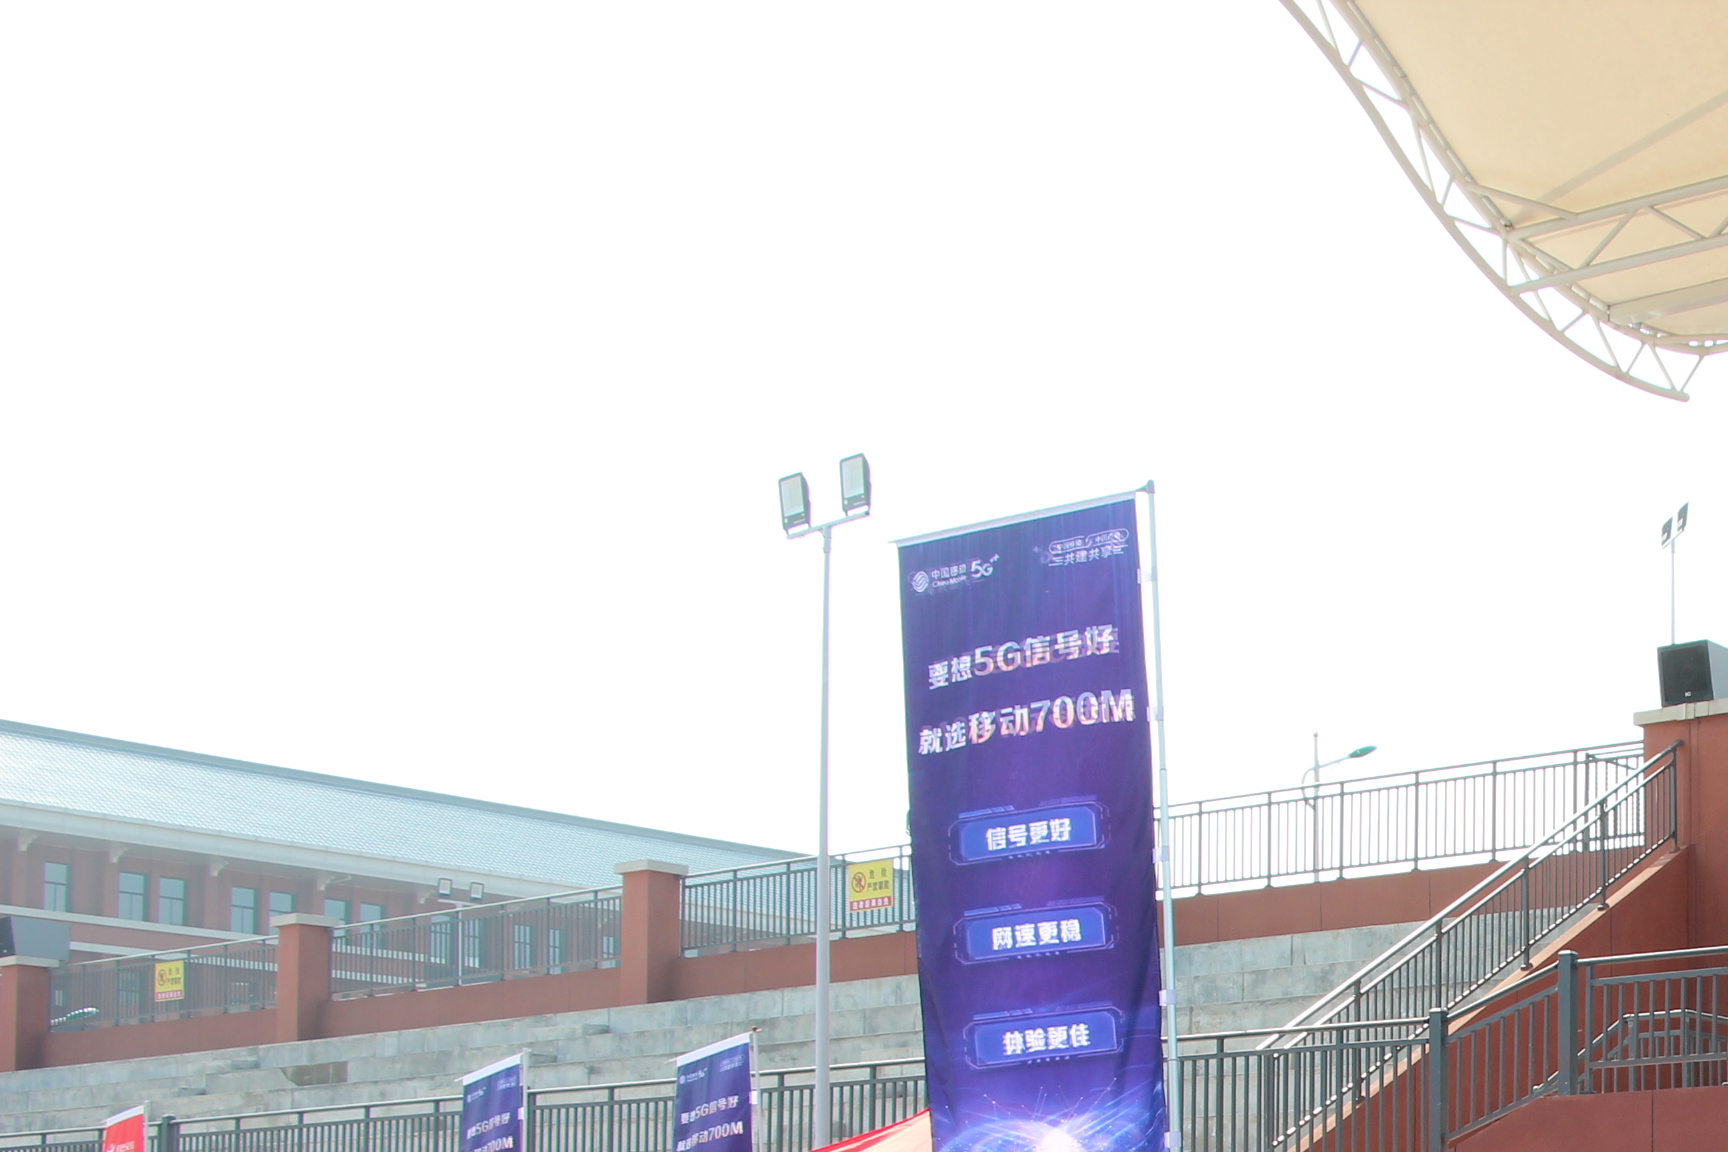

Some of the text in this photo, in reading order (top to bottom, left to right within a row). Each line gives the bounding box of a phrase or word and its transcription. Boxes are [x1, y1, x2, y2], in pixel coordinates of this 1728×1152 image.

[928, 624, 1116, 690] 要想5G信号好
[918, 688, 1135, 755] 就选移动700M
[986, 818, 1072, 851] 信号更好
[992, 918, 1082, 951] 网速更稳
[1003, 1022, 1090, 1055] 体验更佳
